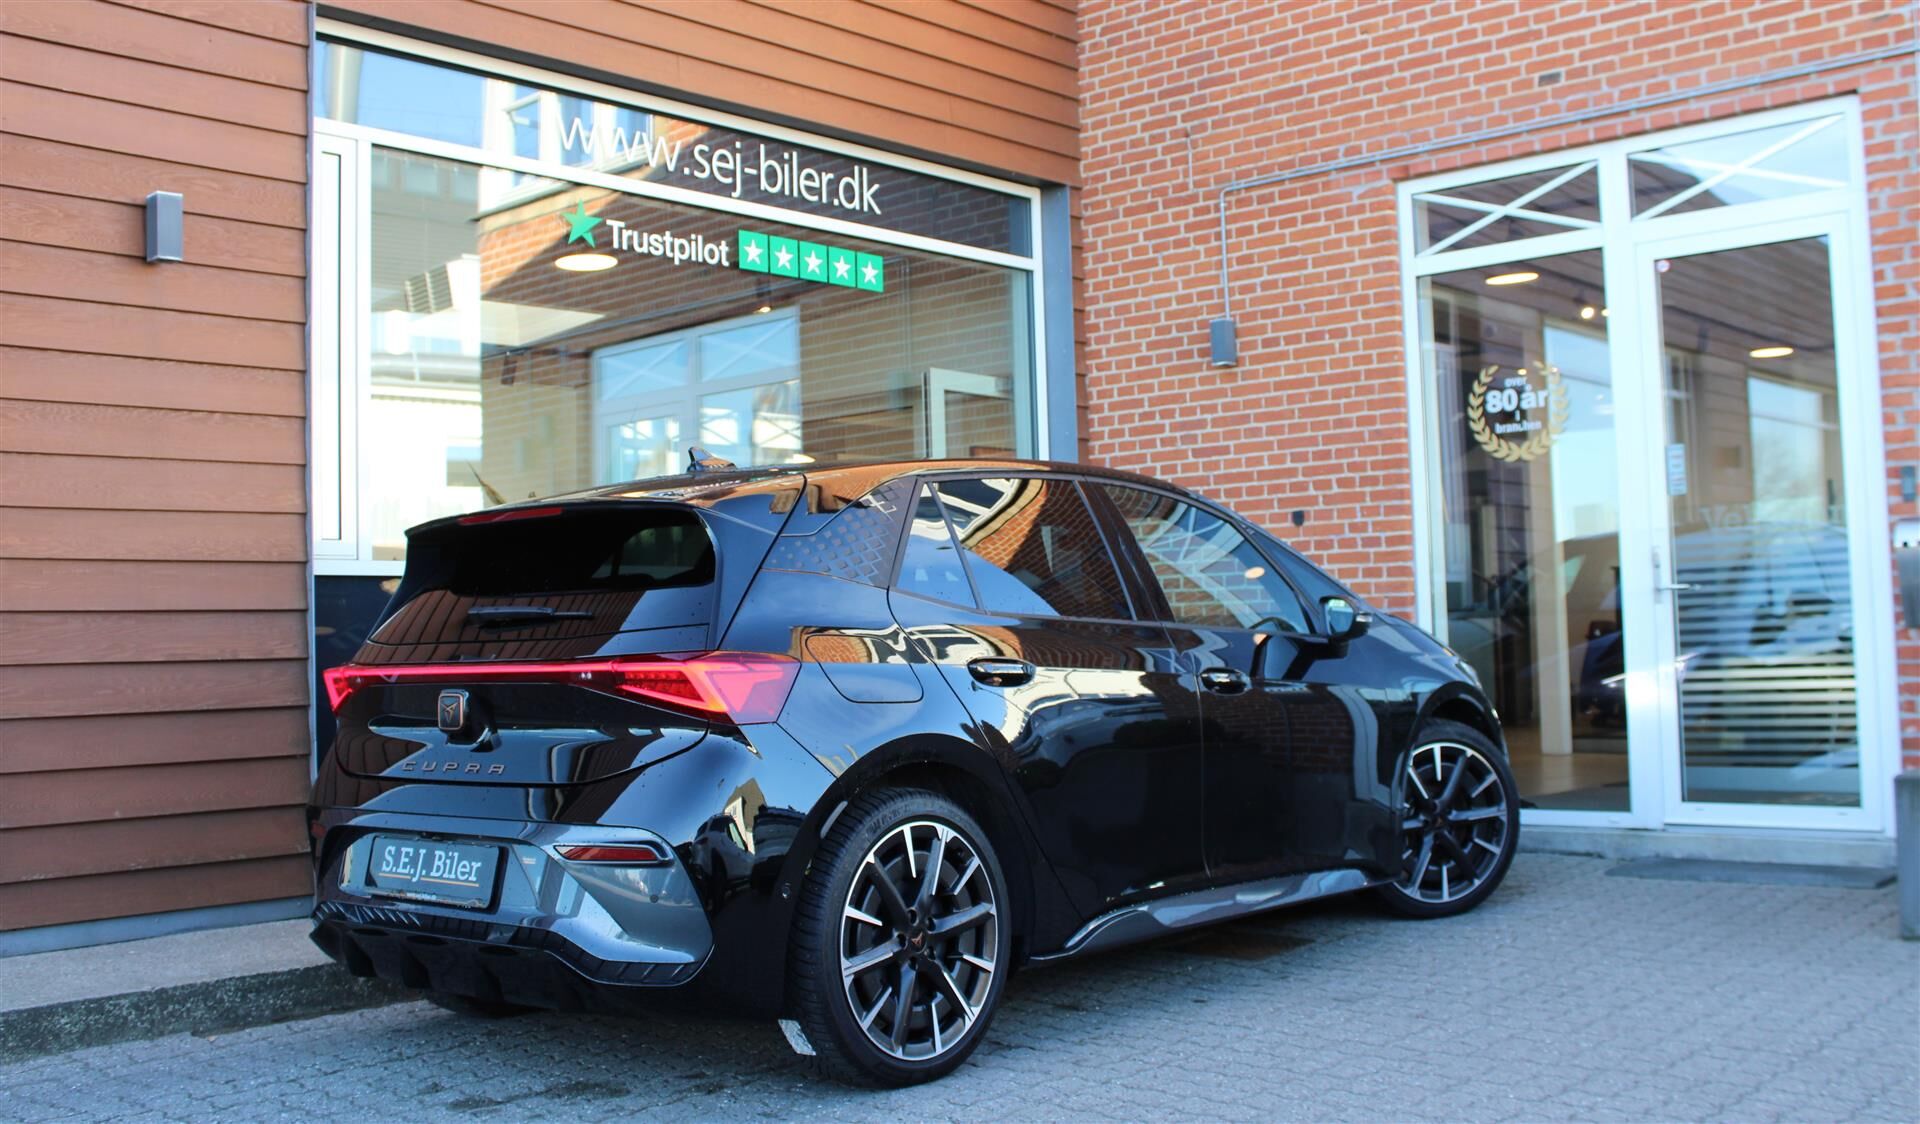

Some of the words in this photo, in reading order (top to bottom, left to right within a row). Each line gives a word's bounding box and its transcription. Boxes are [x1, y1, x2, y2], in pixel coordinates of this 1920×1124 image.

[555, 112, 882, 214] www.sej-biler.dk
[606, 219, 730, 267] Trustpilot
[1485, 388, 1519, 413] 80
[1520, 384, 1548, 409] år
[401, 760, 506, 775] CUPRA
[381, 845, 427, 882] S.E.J.
[430, 846, 482, 882] Biler
